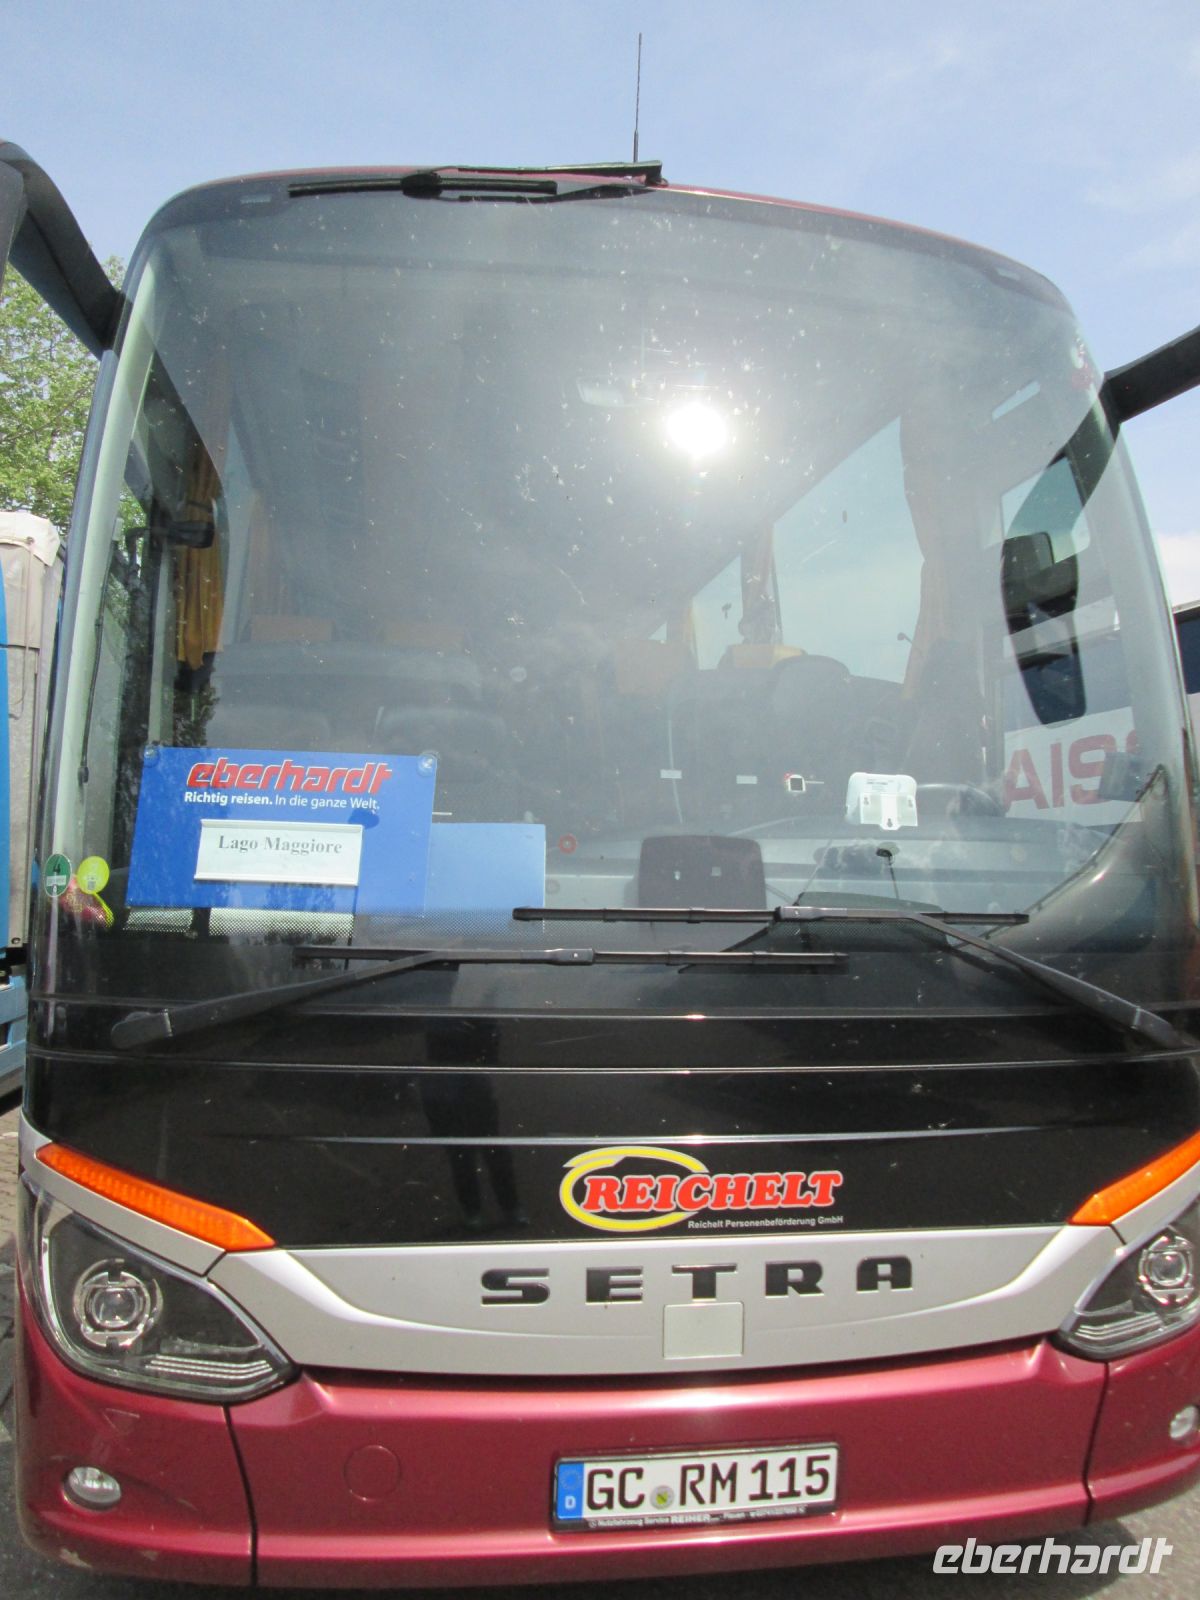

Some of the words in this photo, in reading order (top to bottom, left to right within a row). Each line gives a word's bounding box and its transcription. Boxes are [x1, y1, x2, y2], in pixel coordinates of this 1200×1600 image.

[186, 757, 393, 795] eberhardt
[184, 791, 228, 806] Richtig
[230, 794, 273, 806] reisen.
[275, 795, 286, 806] In
[289, 795, 308, 807] die
[311, 799, 347, 810] ganze
[350, 797, 380, 810] Welt.
[218, 835, 259, 854] Lago
[264, 837, 343, 855] Maggiore
[582, 1171, 844, 1212] REICHELT
[688, 1218, 724, 1229] Reichelt
[725, 1216, 816, 1229] Personenbeförderung
[817, 1215, 844, 1226] GmbH
[480, 1255, 913, 1306] SETRA
[586, 1467, 645, 1511] GC
[679, 1462, 738, 1506] RM
[748, 1454, 831, 1501] 115
[564, 1495, 576, 1509] D
